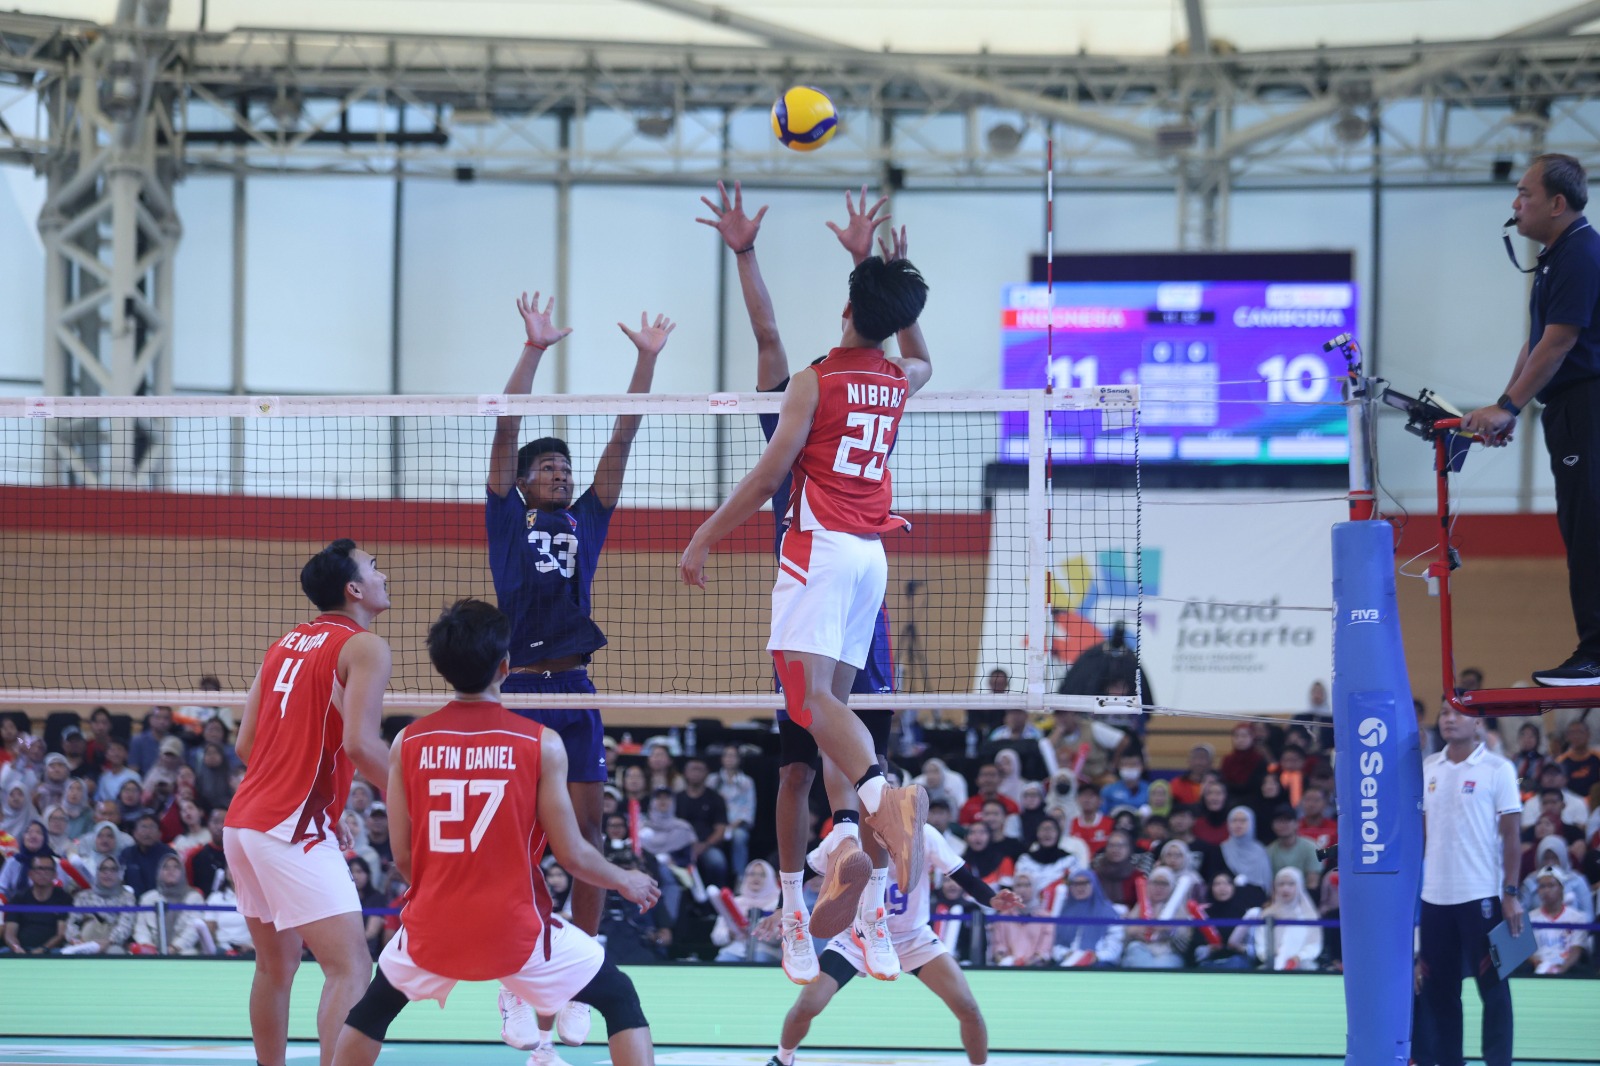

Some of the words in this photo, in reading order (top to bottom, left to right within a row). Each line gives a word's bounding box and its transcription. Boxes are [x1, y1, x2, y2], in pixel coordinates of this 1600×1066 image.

[1017, 307, 1125, 328] INDONESIA
[1233, 306, 1345, 328] CAMBODIA
[1258, 354, 1329, 404] 10
[833, 412, 895, 481] 25
[527, 531, 579, 579] 33
[1179, 594, 1281, 623] Abad
[1351, 609, 1379, 620] FIVB
[1176, 625, 1315, 650] Jakarta
[273, 657, 305, 719] 4
[419, 745, 461, 770] ALFIN
[465, 745, 517, 770] DANIEL
[428, 779, 509, 853] 27
[1360, 751, 1385, 865] Senoh
